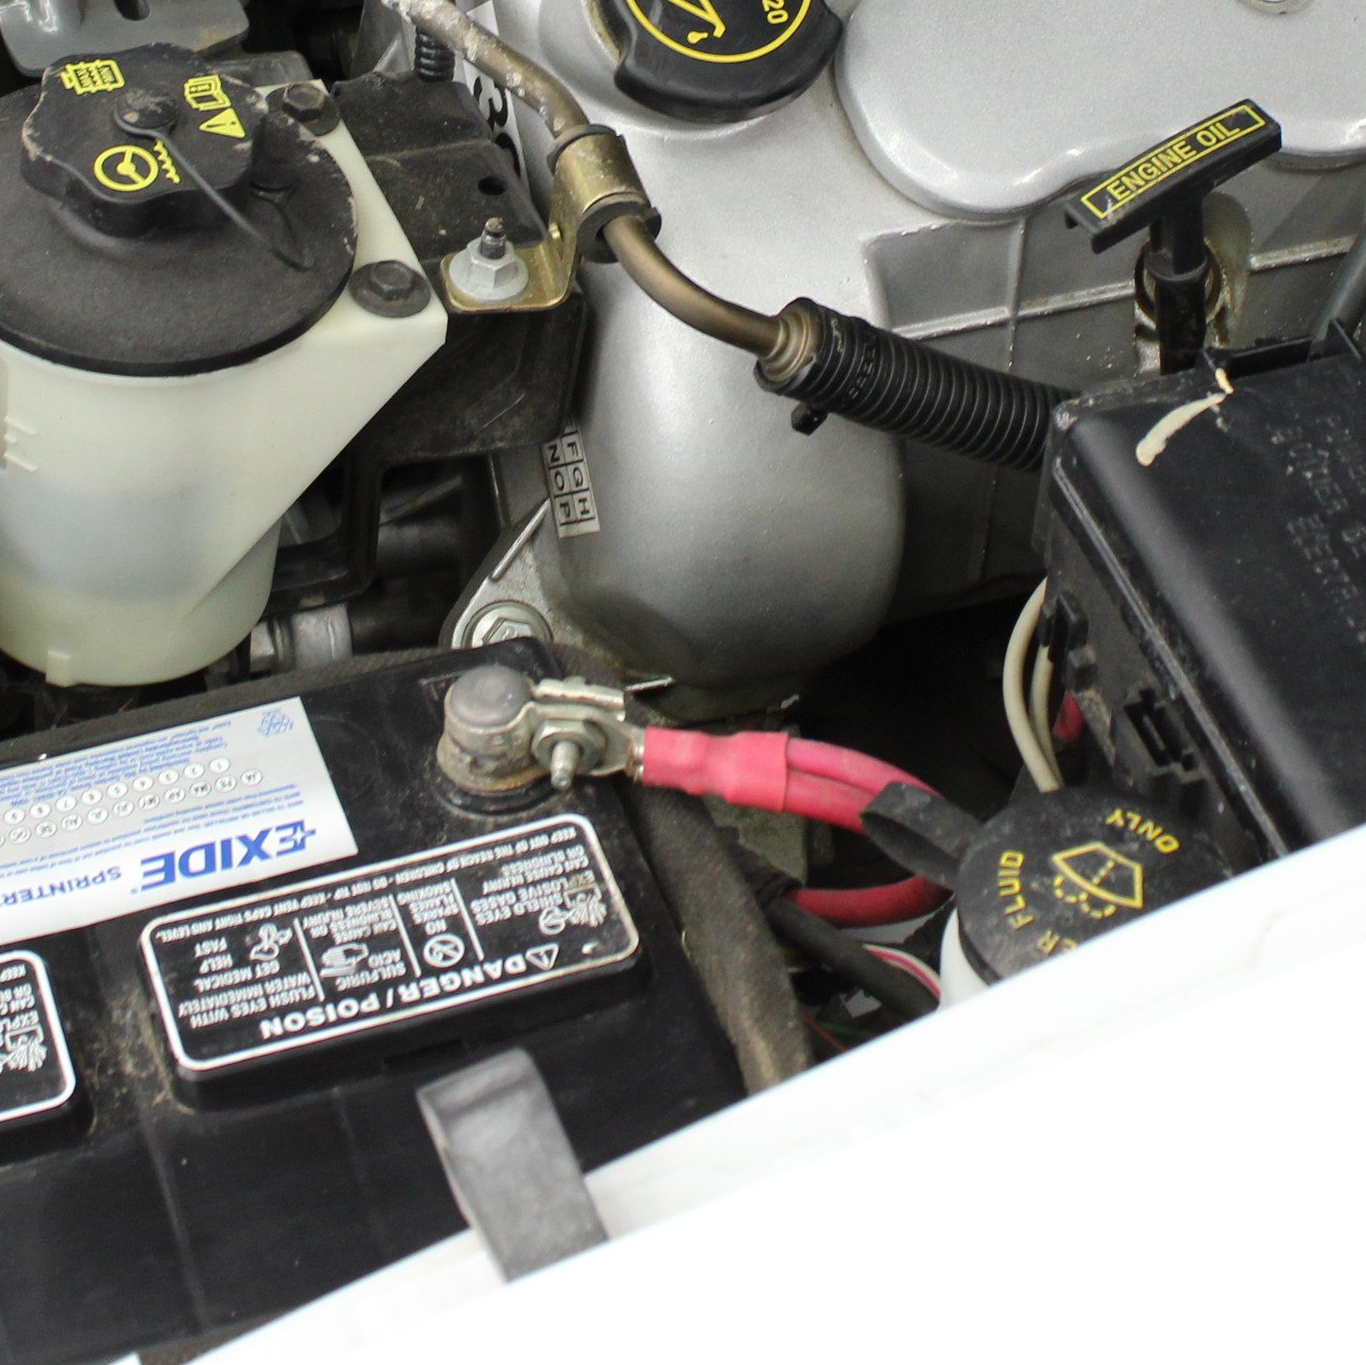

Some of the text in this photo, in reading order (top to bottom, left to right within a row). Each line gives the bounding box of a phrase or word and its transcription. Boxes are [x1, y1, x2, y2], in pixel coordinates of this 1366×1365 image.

[1107, 119, 1239, 202] ENGINE OIL
[567, 442, 579, 456] F
[578, 498, 590, 515] H
[550, 827, 576, 844] KEEP
[1105, 807, 1180, 855] ONLY
[494, 844, 514, 859] THE
[515, 840, 529, 854] OF
[529, 835, 549, 850] OUT
[141, 820, 316, 891] EXIDE
[441, 857, 460, 872] OF
[455, 849, 494, 868] REACH
[501, 845, 587, 879] OR BLINDNESS
[372, 876, 388, 890] DO
[395, 862, 445, 885] CHILDREN
[483, 854, 589, 895] CAN CAUSE INJURY
[3, 867, 121, 905] SPRINTER
[333, 886, 351, 900] TIP
[351, 881, 372, 896] NOT
[397, 881, 454, 905] SMOKING
[470, 870, 596, 914] EXPLOSIVE GASES
[996, 849, 1034, 930] FLUID
[273, 899, 300, 916] VENT
[296, 892, 327, 909] KEEP
[409, 891, 456, 914] FLAMES
[473, 890, 563, 925] SHIELD EYES
[215, 913, 244, 930] TIGHT
[243, 905, 272, 922] CAPS
[303, 897, 393, 929] SEVERE INJURY
[307, 907, 392, 938] BLINDNESS OR
[411, 901, 459, 924] SPARKS
[187, 920, 213, 935] AND
[332, 917, 398, 945] CAN CAUSE
[425, 919, 447, 935] NO
[195, 937, 227, 958] FAST
[199, 953, 233, 974] HELP
[364, 949, 401, 968] ACID
[0, 964, 26, 982] KEEP
[194, 957, 280, 992] GET MEDICAL
[335, 961, 406, 991] SULFURIC
[398, 954, 526, 1002] DANGER
[7, 994, 35, 1013] CAN
[13, 984, 34, 1002] OR
[179, 972, 311, 1017] WATER IMMEDIATELY
[190, 985, 315, 1028] FLUSH EYES WITH
[260, 993, 380, 1039] POISON
